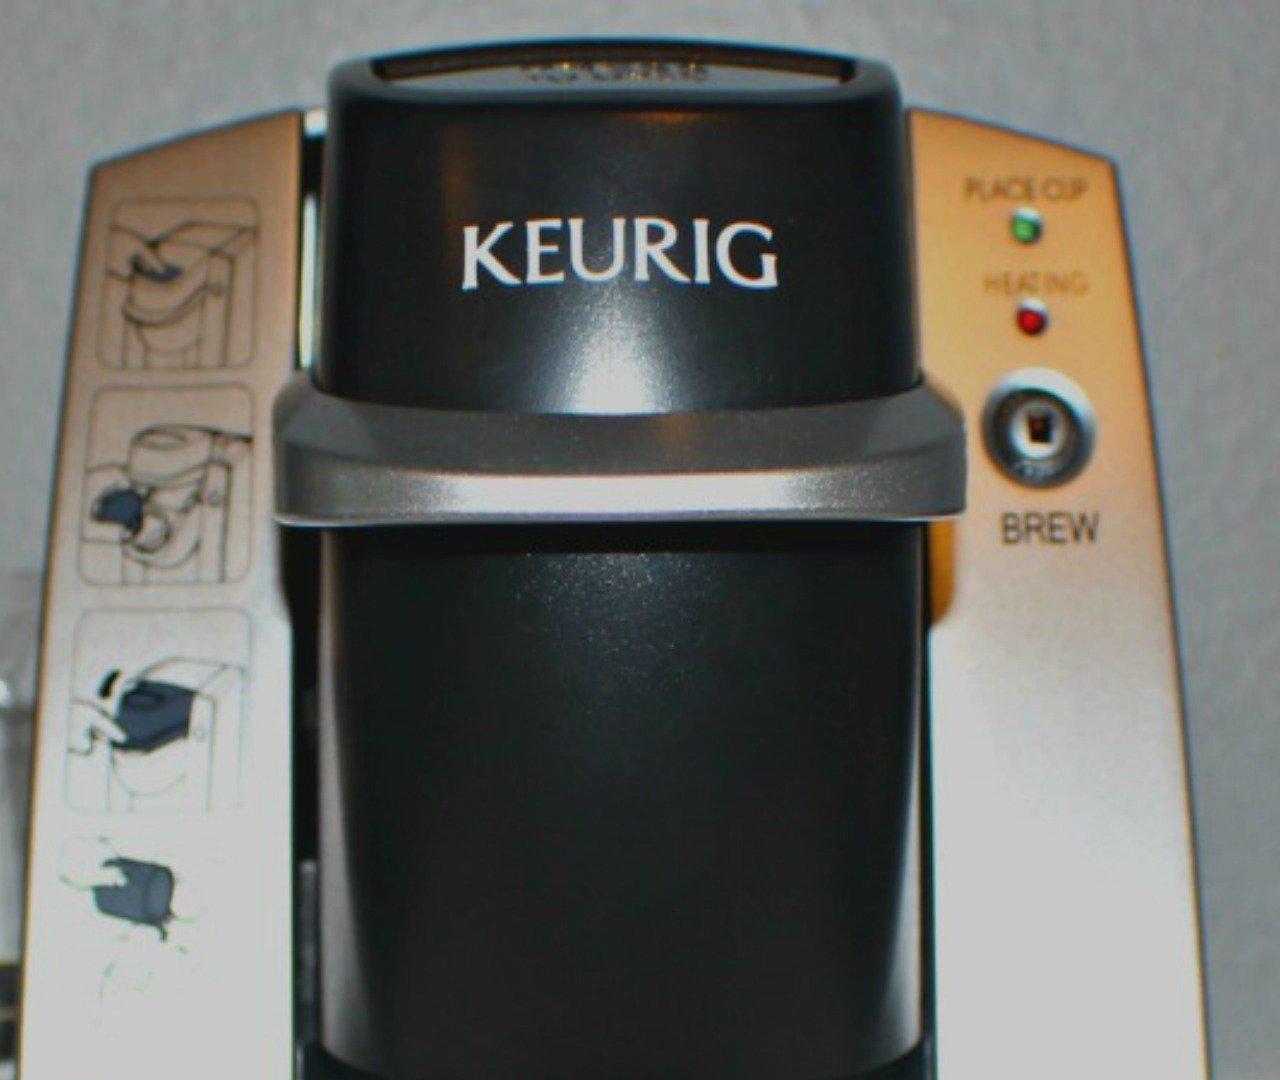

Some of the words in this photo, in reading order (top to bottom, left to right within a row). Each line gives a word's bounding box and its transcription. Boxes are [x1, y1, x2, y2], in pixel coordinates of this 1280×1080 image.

[461, 216, 778, 290] KEURIG
[984, 271, 1090, 296] HEATING
[1002, 512, 1100, 545] BREW
